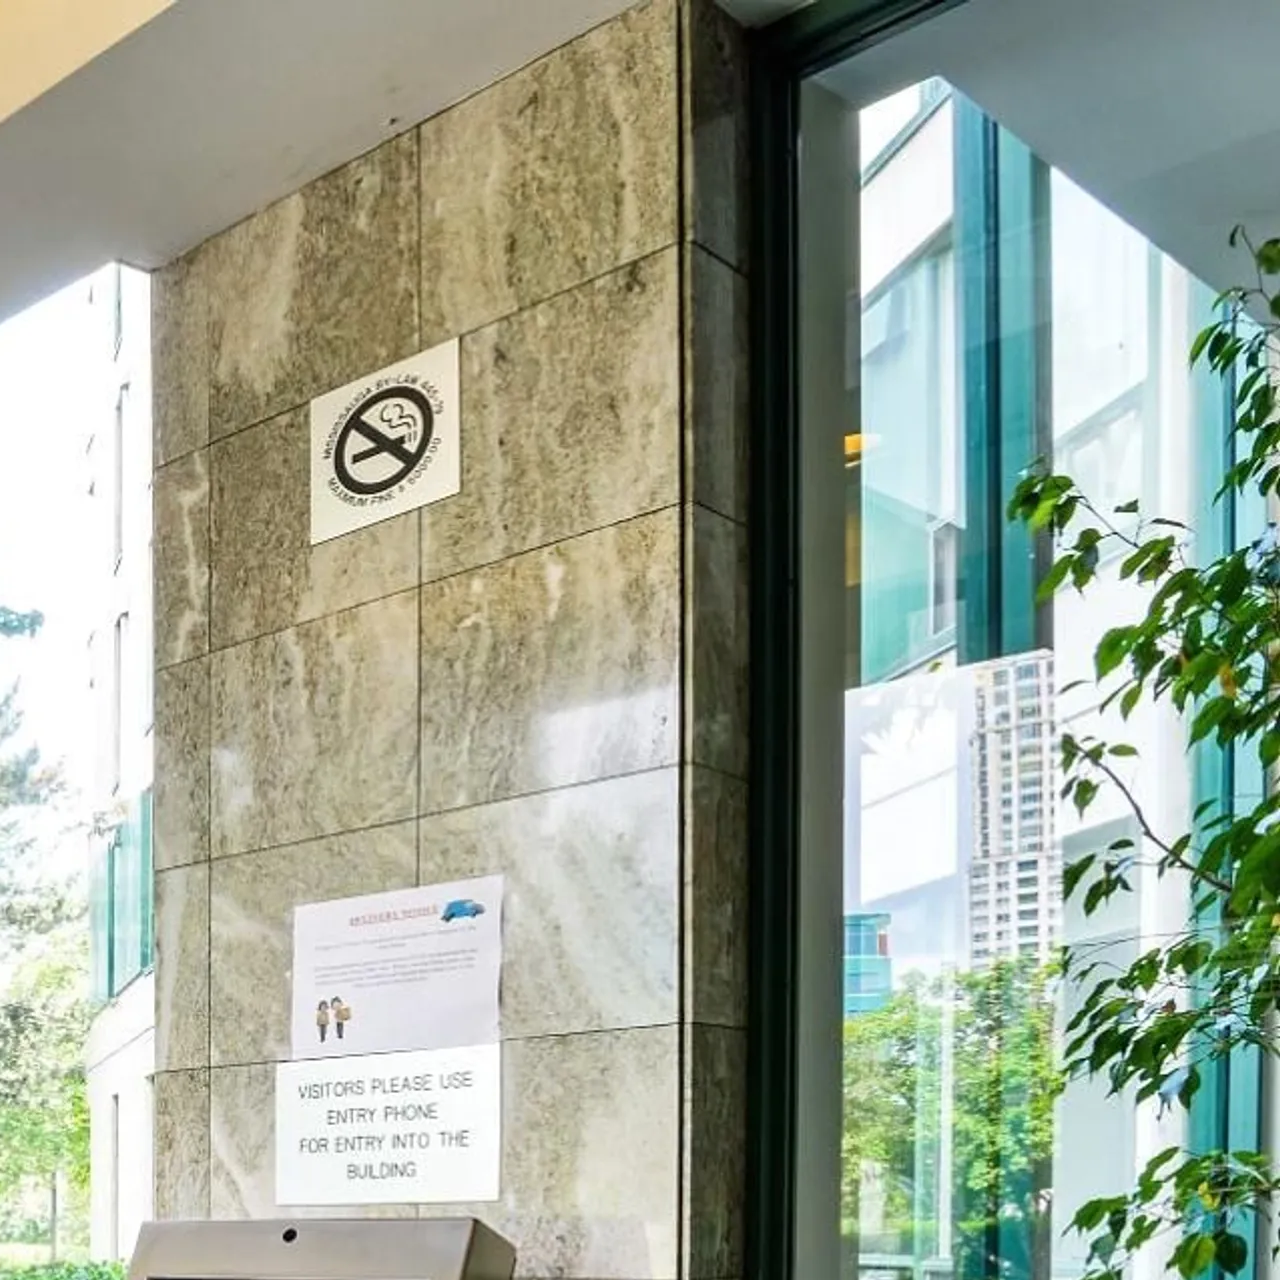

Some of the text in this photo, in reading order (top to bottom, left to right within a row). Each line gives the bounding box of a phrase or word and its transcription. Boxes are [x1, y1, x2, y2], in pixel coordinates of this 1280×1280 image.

[298, 1071, 473, 1100] VISITORS PLEASE USE
[327, 1102, 439, 1126] ENTRY PHONE
[299, 1130, 470, 1154] FOR ENTRY INTO THE
[346, 1161, 417, 1180] BUILDING
